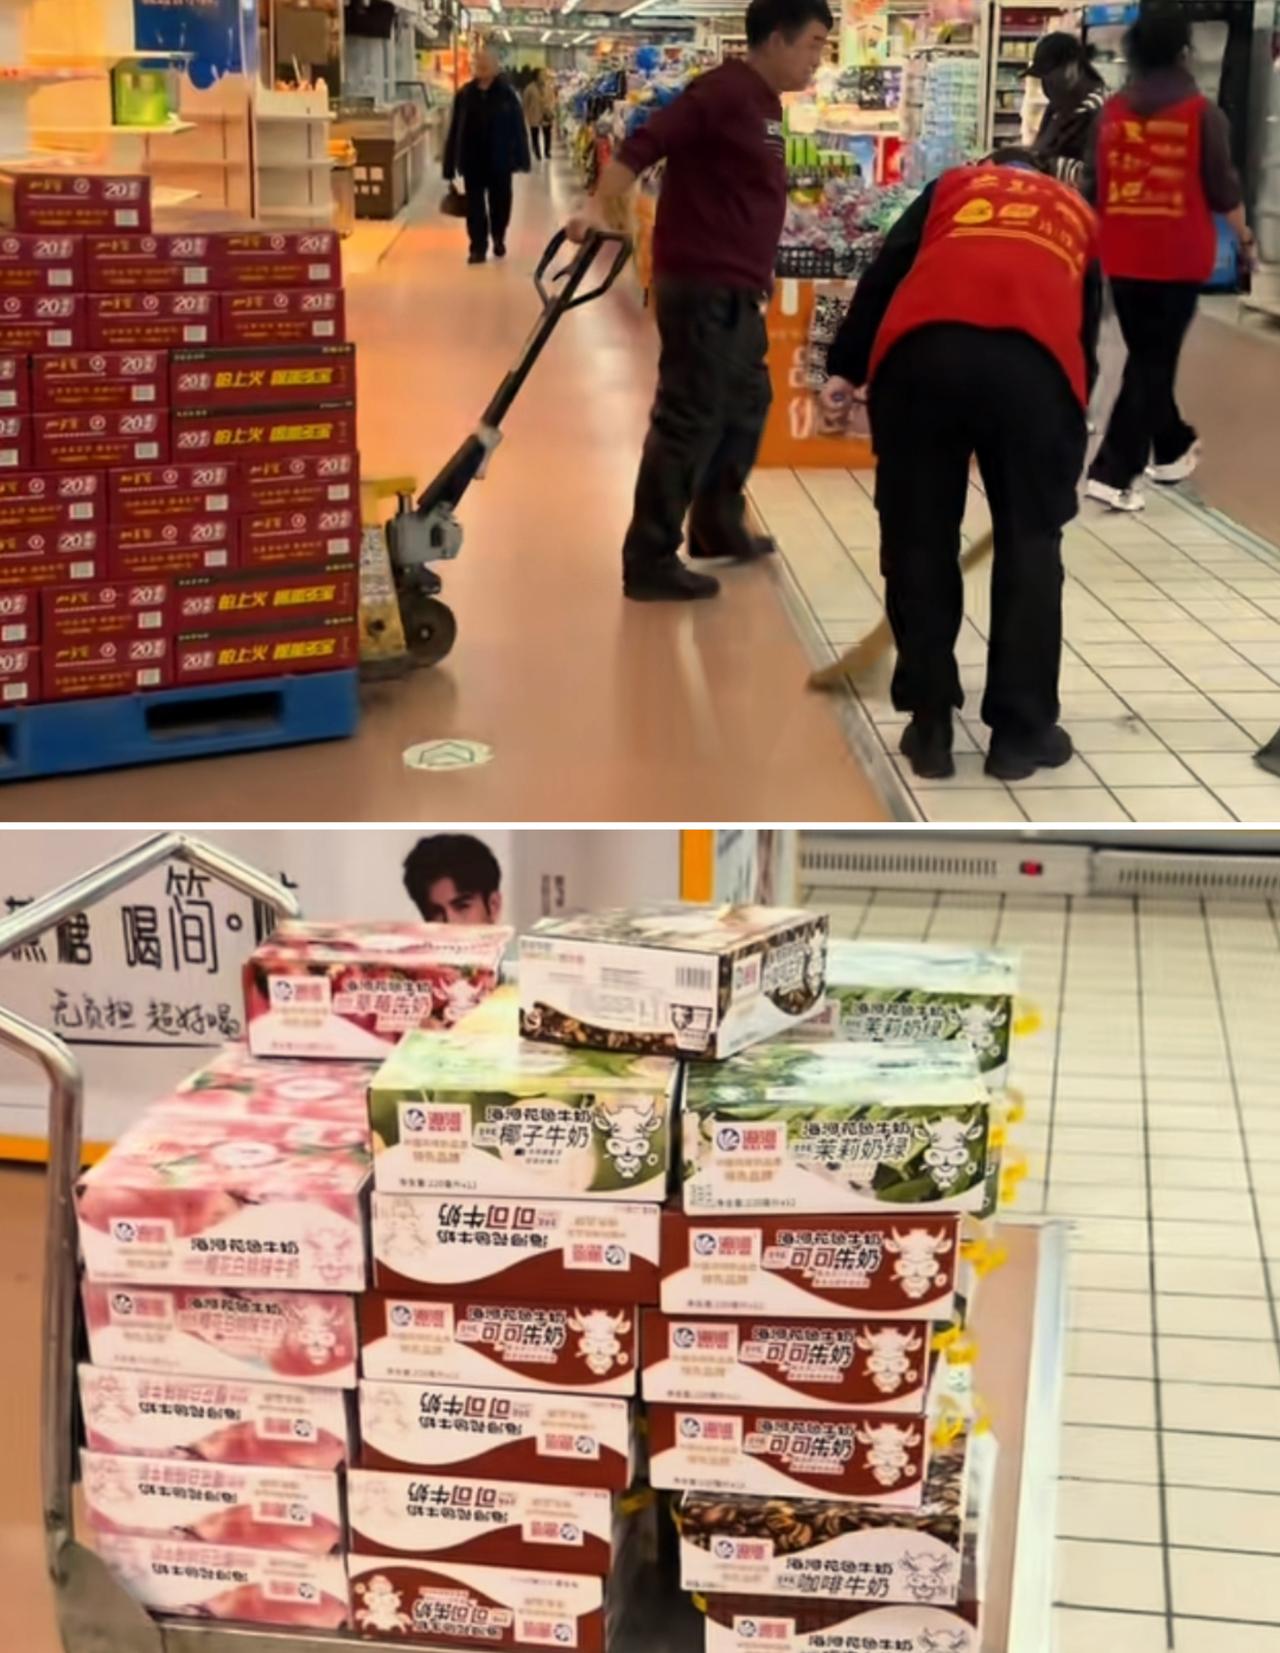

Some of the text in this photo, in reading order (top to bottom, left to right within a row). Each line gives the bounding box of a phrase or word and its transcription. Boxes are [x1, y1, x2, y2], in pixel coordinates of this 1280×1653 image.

[50, 988, 135, 1030] 无负担
[145, 1000, 242, 1038] 超好喝
[500, 1124, 590, 1148] 椰子牛奶
[814, 1139, 909, 1161] 茉莉奶绿
[438, 1203, 536, 1230] 可可牛奶
[791, 1248, 881, 1271] 可可牛奶
[482, 1323, 566, 1346] 可可牛奶
[766, 1344, 852, 1366] 可可牛奶
[420, 1393, 510, 1418] 可可牛奶
[769, 1437, 854, 1459] 可可牛奶
[408, 1482, 496, 1508] 可可牛奶
[797, 1574, 890, 1598] 咖啡牛奶
[414, 1600, 488, 1624] 可可牛奶
